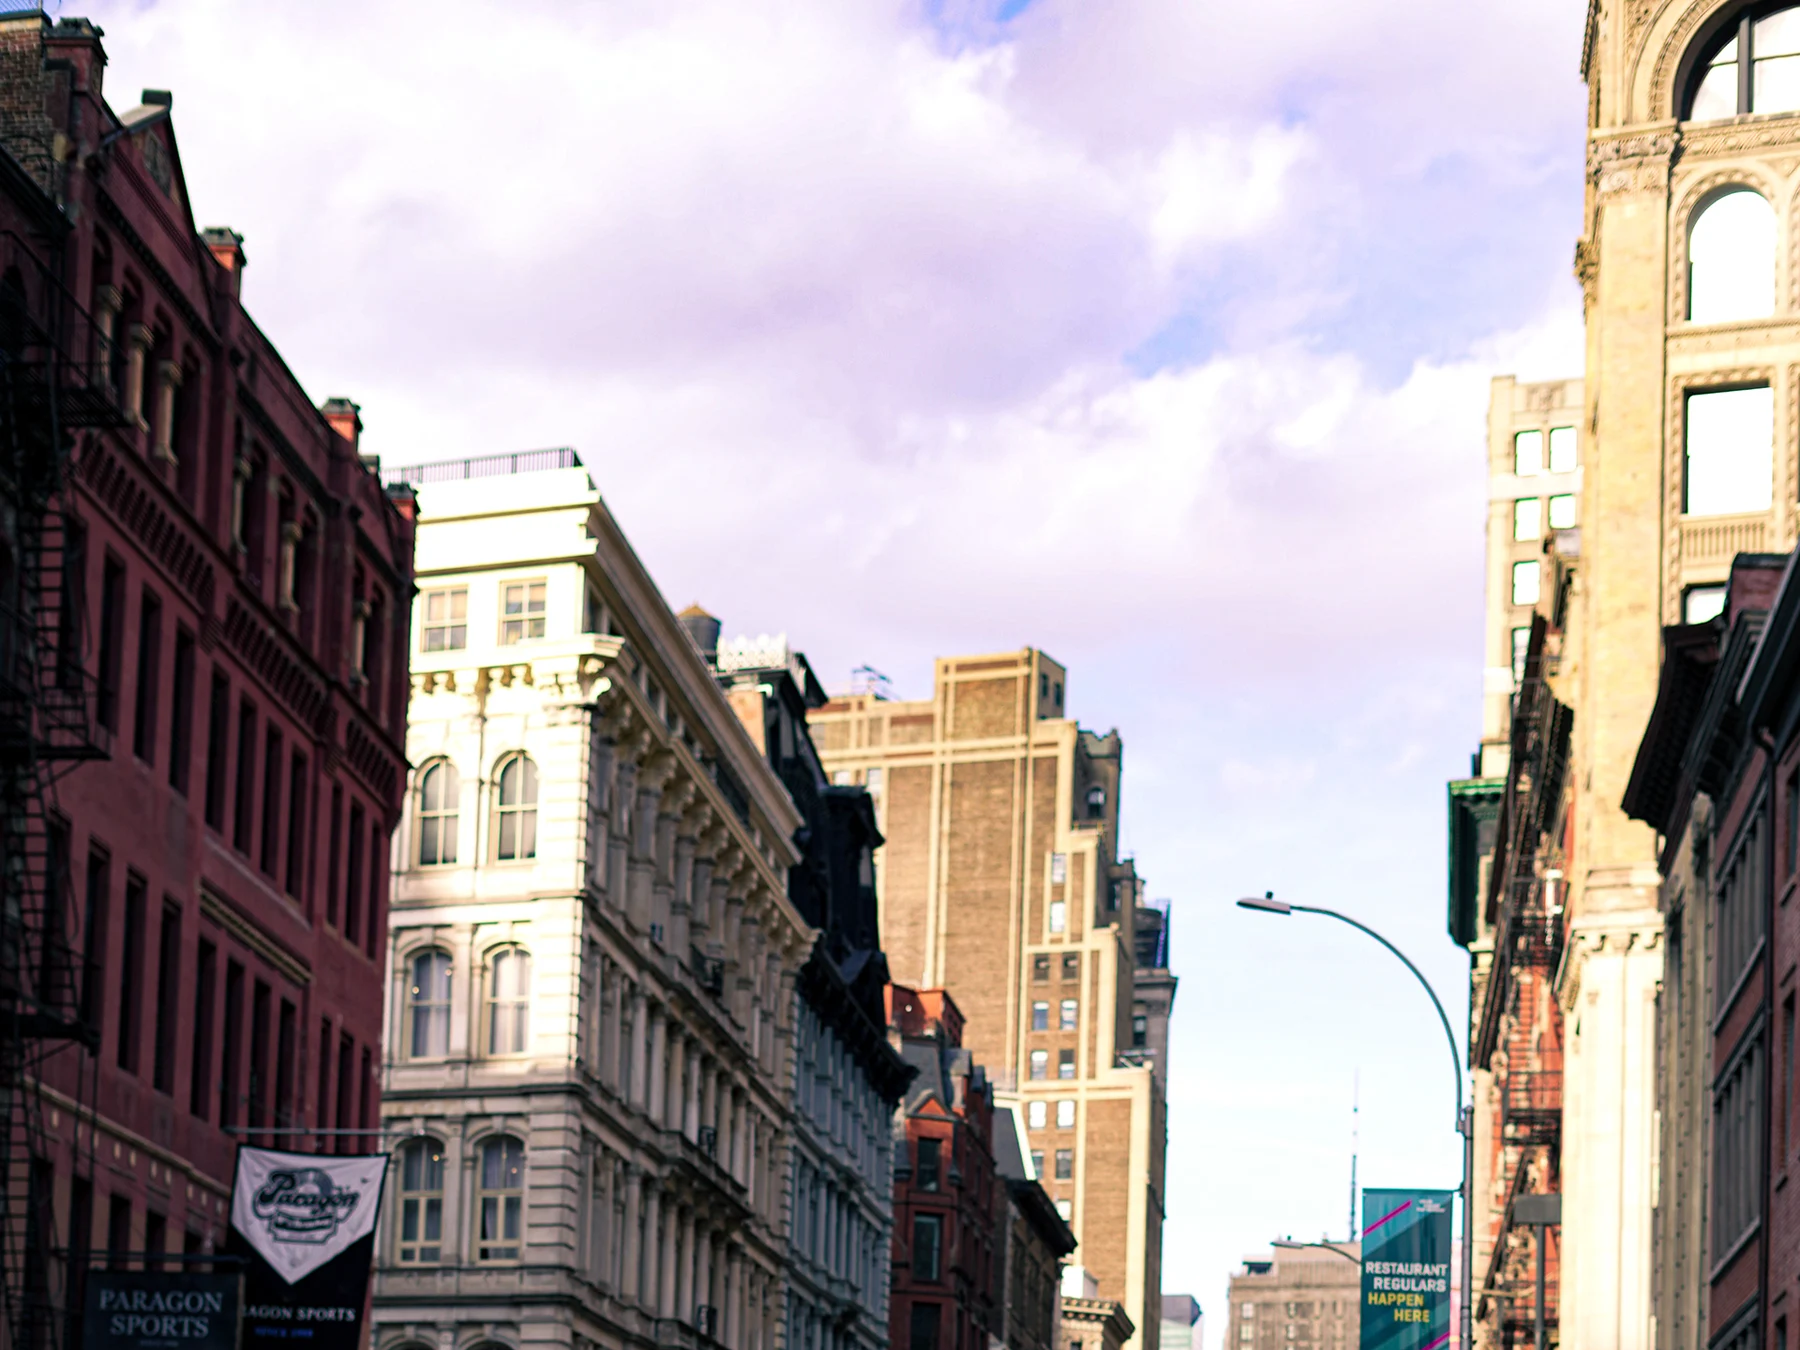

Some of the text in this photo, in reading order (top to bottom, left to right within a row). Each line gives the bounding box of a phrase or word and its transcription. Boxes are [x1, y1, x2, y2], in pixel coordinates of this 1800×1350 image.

[257, 1171, 361, 1216] Paragon
[1365, 1261, 1448, 1275] RESTAURANT
[1373, 1277, 1446, 1292] REGULARS
[100, 1289, 223, 1313] PARAGON
[1368, 1292, 1424, 1306] HAPPEN
[242, 1304, 356, 1322] AGON SPORTS
[1394, 1308, 1430, 1322] HERE
[110, 1314, 210, 1338] SPORTS
